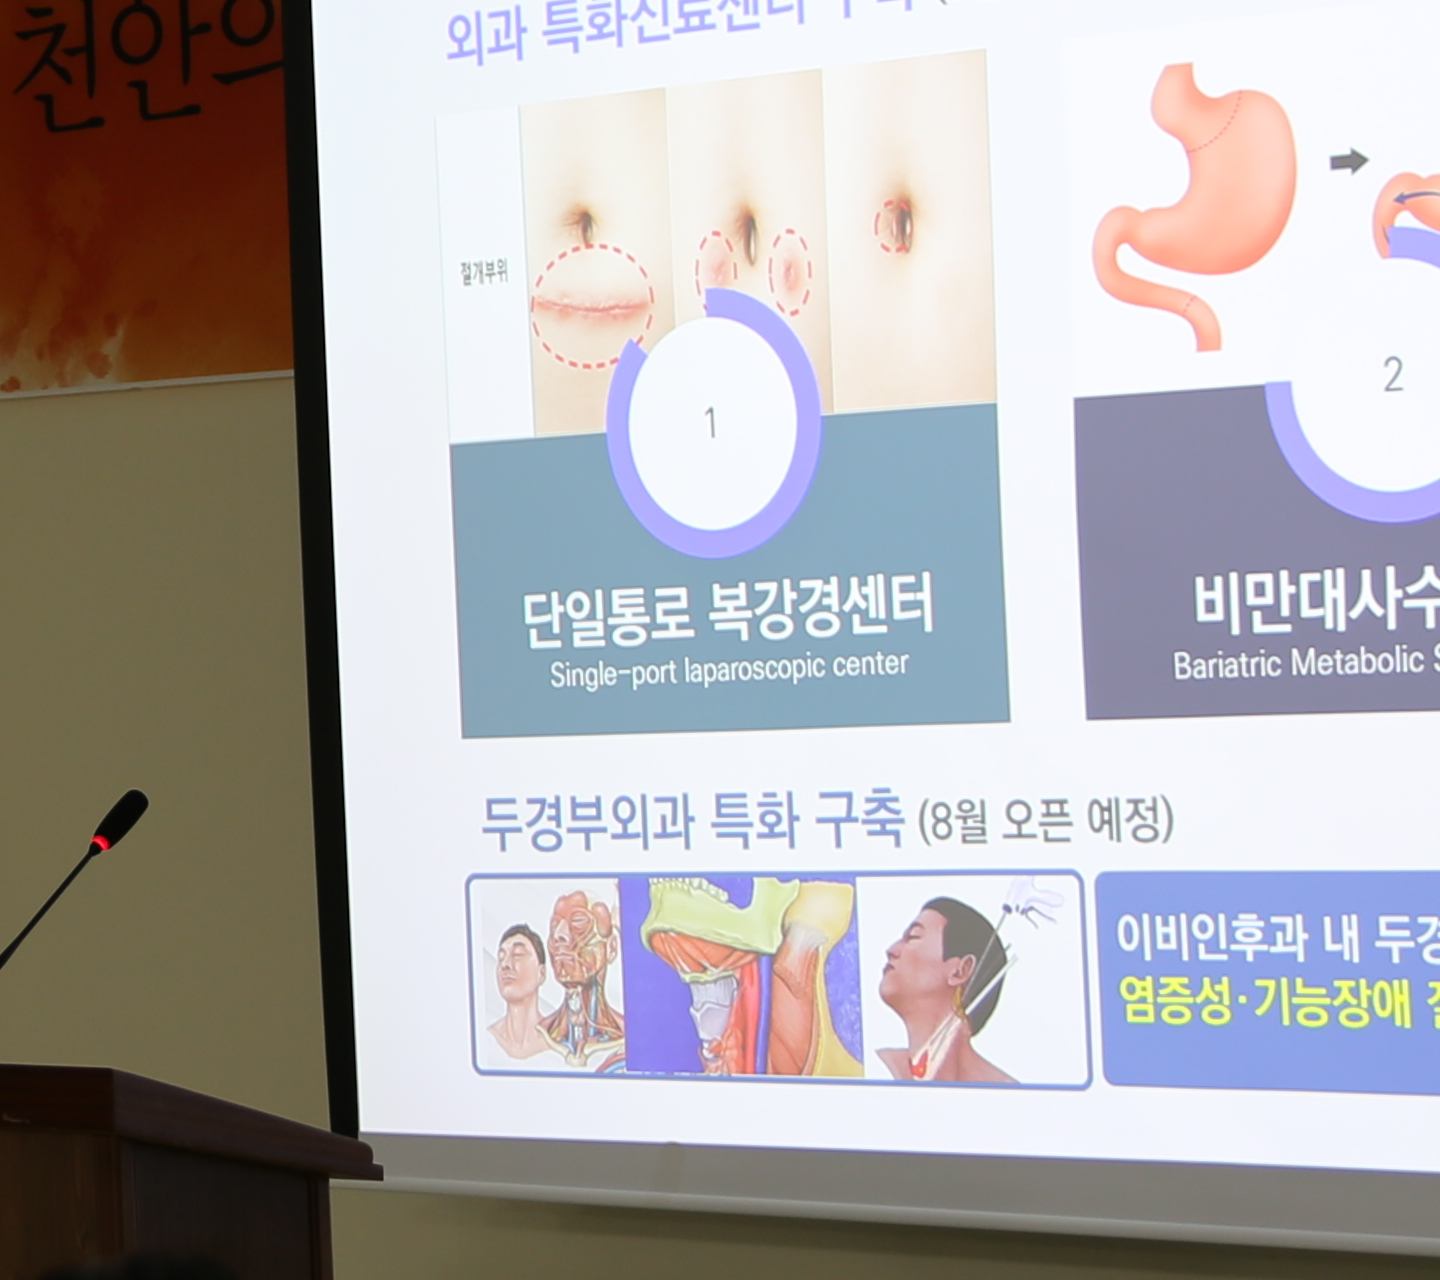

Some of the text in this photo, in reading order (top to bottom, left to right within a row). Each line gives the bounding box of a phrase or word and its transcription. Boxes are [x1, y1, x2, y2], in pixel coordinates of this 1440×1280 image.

[447, 5, 527, 66] 외과
[461, 259, 507, 286] 절개부위
[1384, 356, 1403, 392] 2
[705, 407, 715, 438] 1
[524, 572, 932, 648] 단일통로 복강경센터
[551, 652, 909, 692] Single-port laparoscopic center
[1175, 649, 1281, 679] Bariatric
[1292, 645, 1424, 675] Metabolic
[482, 788, 1173, 852] 두경부외과 특화 구축 (8월 오픈 예정)
[1118, 913, 1308, 962] 이비인후과
[1324, 914, 1359, 963] 내
